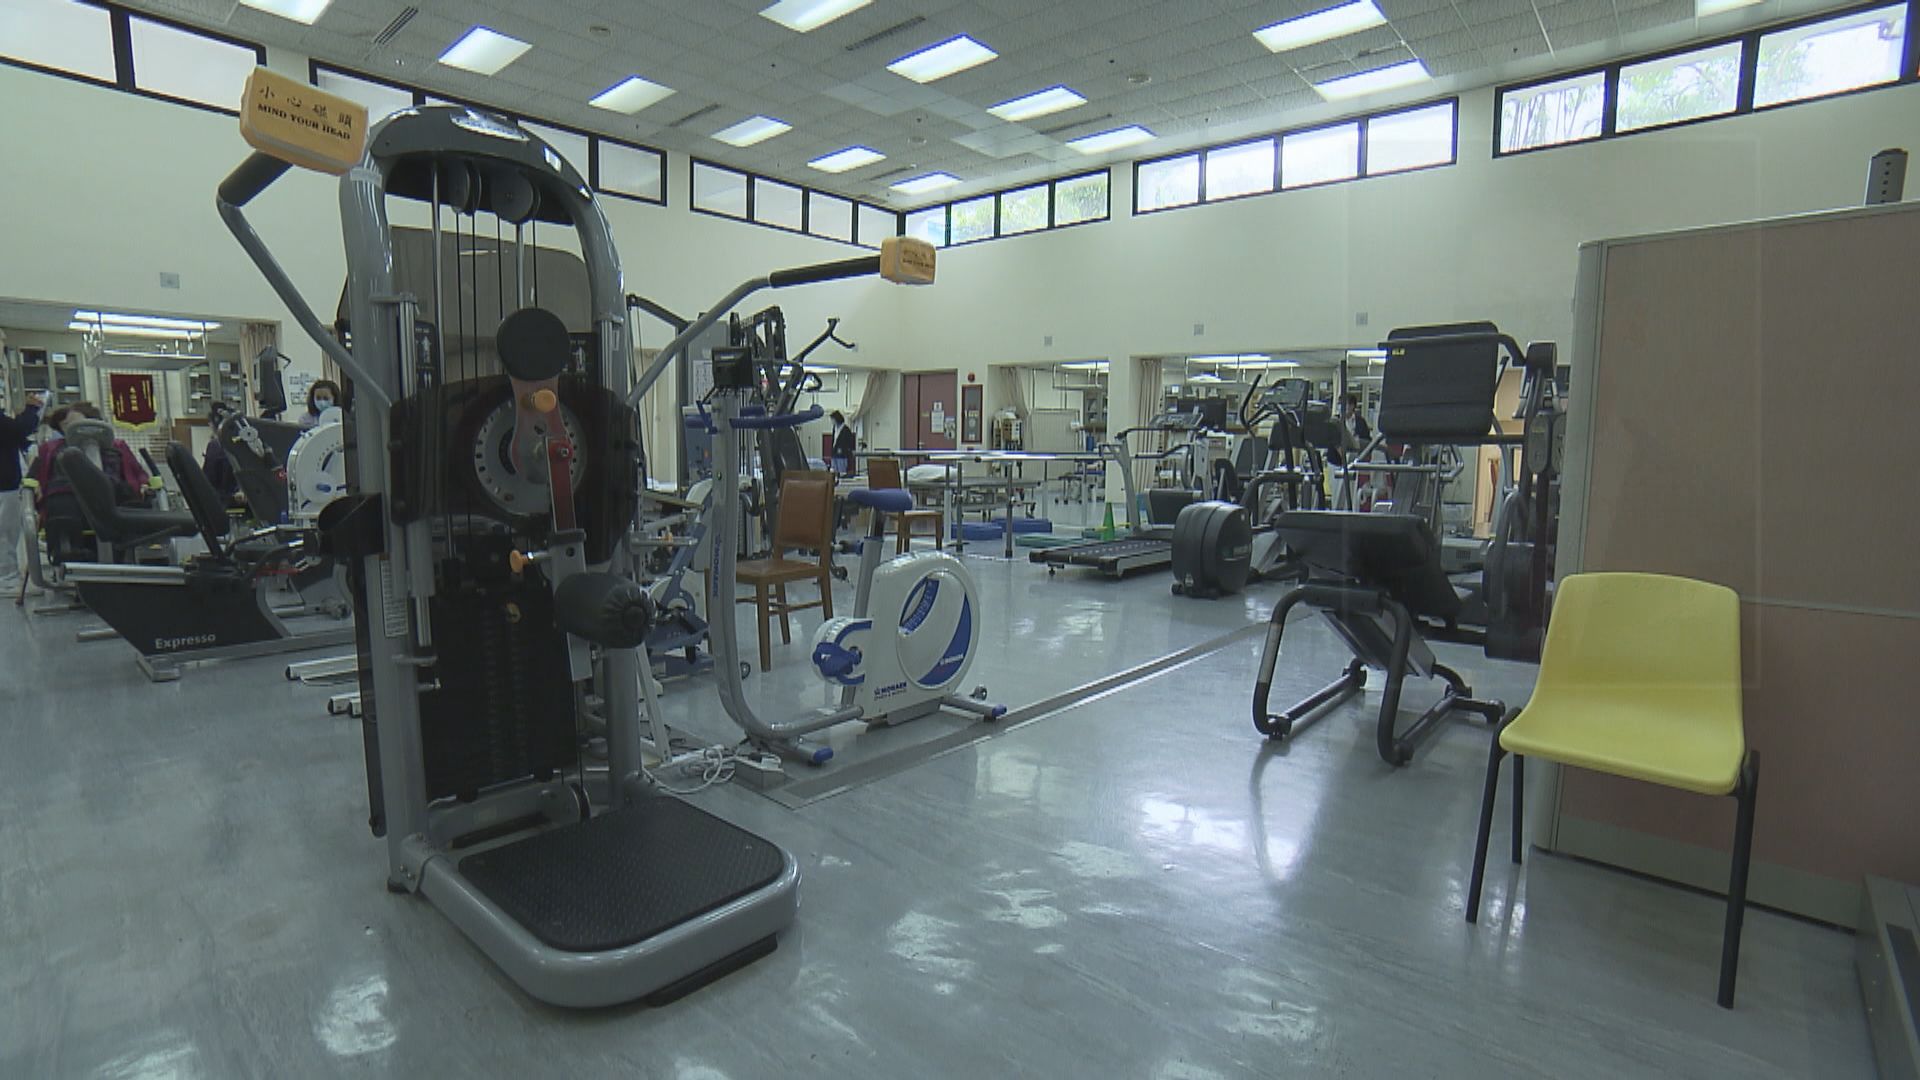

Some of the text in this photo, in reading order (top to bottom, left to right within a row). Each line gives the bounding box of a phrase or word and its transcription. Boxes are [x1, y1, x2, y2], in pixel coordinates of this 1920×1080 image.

[257, 103, 350, 140] MIND YOUR HEAD
[155, 634, 216, 650] Expresso
